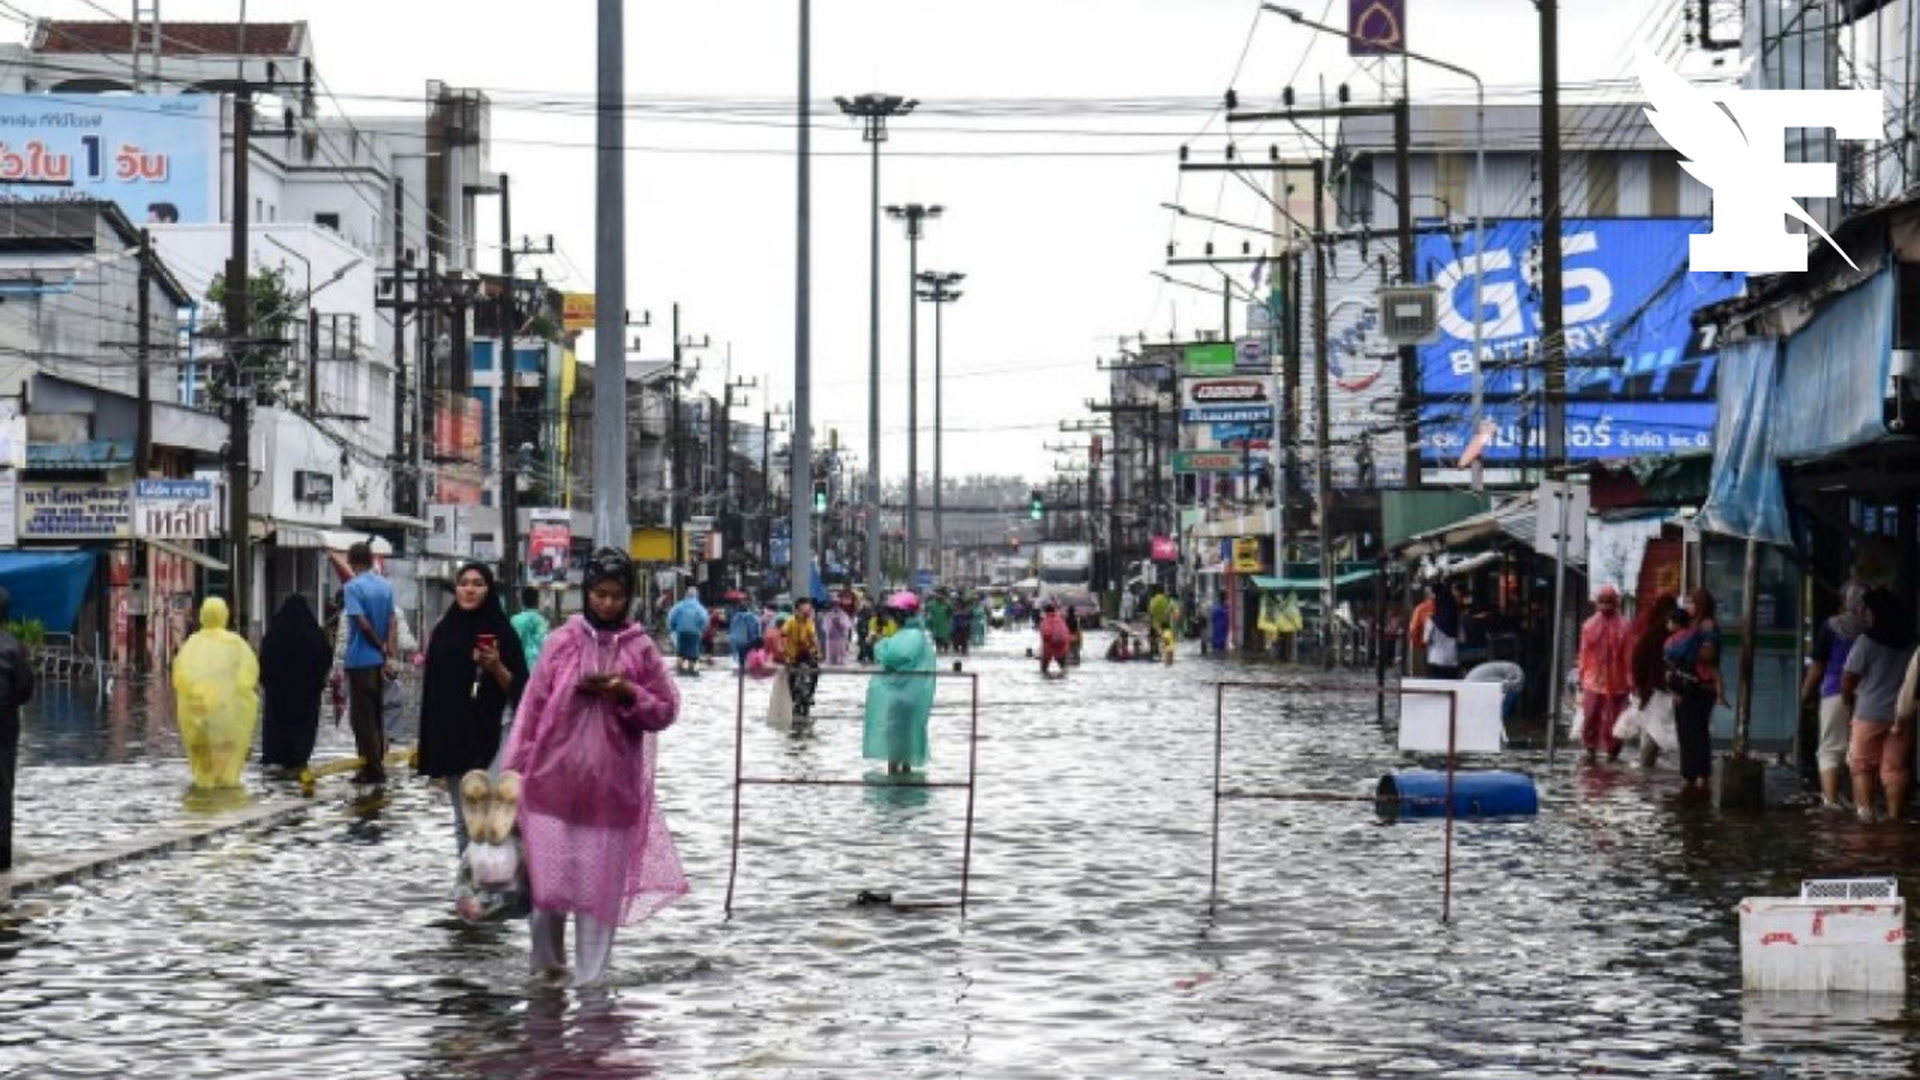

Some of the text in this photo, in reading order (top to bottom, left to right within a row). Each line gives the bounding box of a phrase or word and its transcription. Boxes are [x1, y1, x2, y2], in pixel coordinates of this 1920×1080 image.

[81, 134, 100, 177] 1
[116, 144, 164, 178] วัน
[1437, 231, 1613, 340] GS
[1450, 320, 1611, 376] BATTRY
